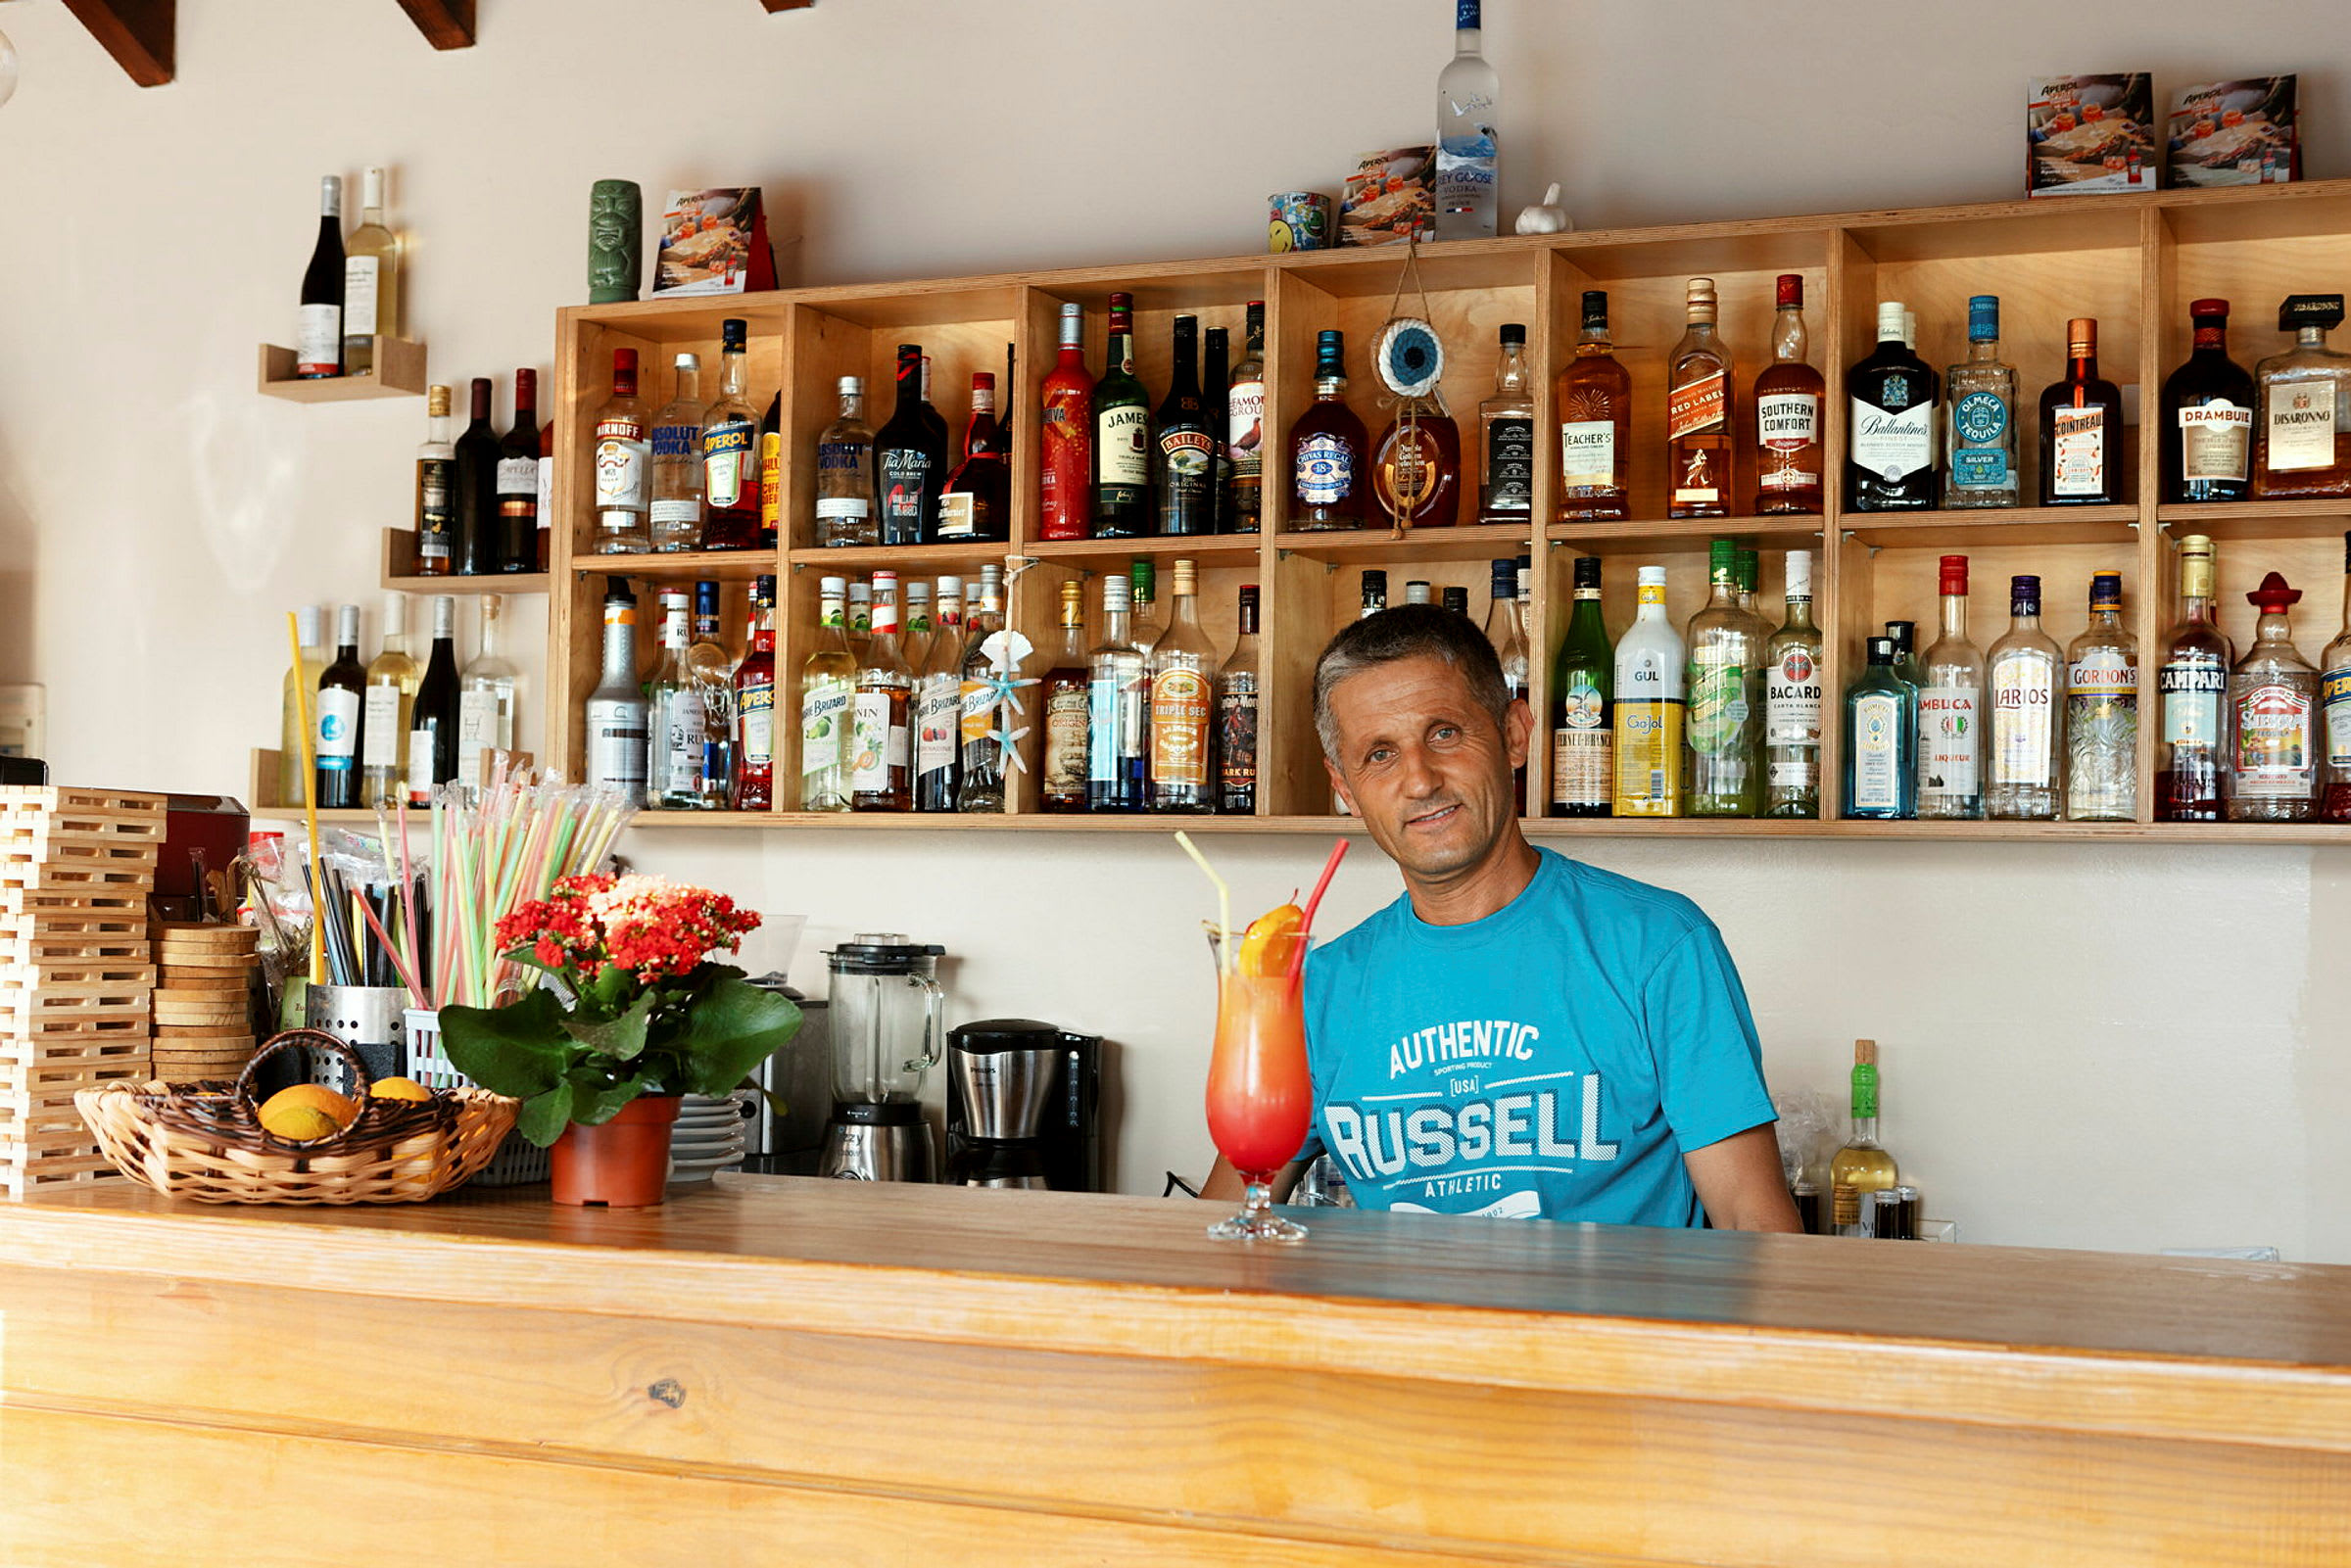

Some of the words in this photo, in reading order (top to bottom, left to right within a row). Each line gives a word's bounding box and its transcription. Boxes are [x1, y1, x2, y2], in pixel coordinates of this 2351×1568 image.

[1456, 172, 1494, 184] GOOSE
[1671, 402, 1691, 415] RED
[1693, 390, 1724, 406] LABEL
[1761, 403, 1814, 419] SOUTHERN
[1961, 396, 2000, 412] OLMECA
[1764, 418, 1811, 431] COMFORT
[2055, 414, 2101, 435] COINTREAU
[2185, 410, 2250, 422] DRAMBUIE
[2274, 410, 2330, 425] DISARONNO
[1859, 415, 1929, 438] Ballantine's
[1961, 422, 2001, 439] TEQUILA
[704, 432, 747, 453] APEROL
[1165, 434, 1213, 452] BAILEYS
[1563, 432, 1611, 448] TEACHER'S
[882, 451, 899, 470] Tia
[1297, 451, 1321, 464] CHIVAS
[1324, 451, 1350, 464] REGAL
[1316, 463, 1326, 473] 18
[1634, 671, 1659, 682] GUL
[2074, 667, 2136, 685] GORDON'S
[2161, 671, 2225, 689] CAMPARI
[740, 689, 774, 709] APERO
[1770, 687, 1822, 699] BACARD
[1995, 689, 2048, 709] LARIOS
[815, 695, 846, 717] BRIZARD
[1156, 704, 1185, 716] TRIPLE
[1189, 706, 1207, 717] SEC
[1390, 1020, 1540, 1080] AUTHENTIC
[1434, 1063, 1466, 1076] SPORTING
[1324, 1071, 1619, 1180] RUSSELL
[1425, 1173, 1502, 1198] ATHLETIC
